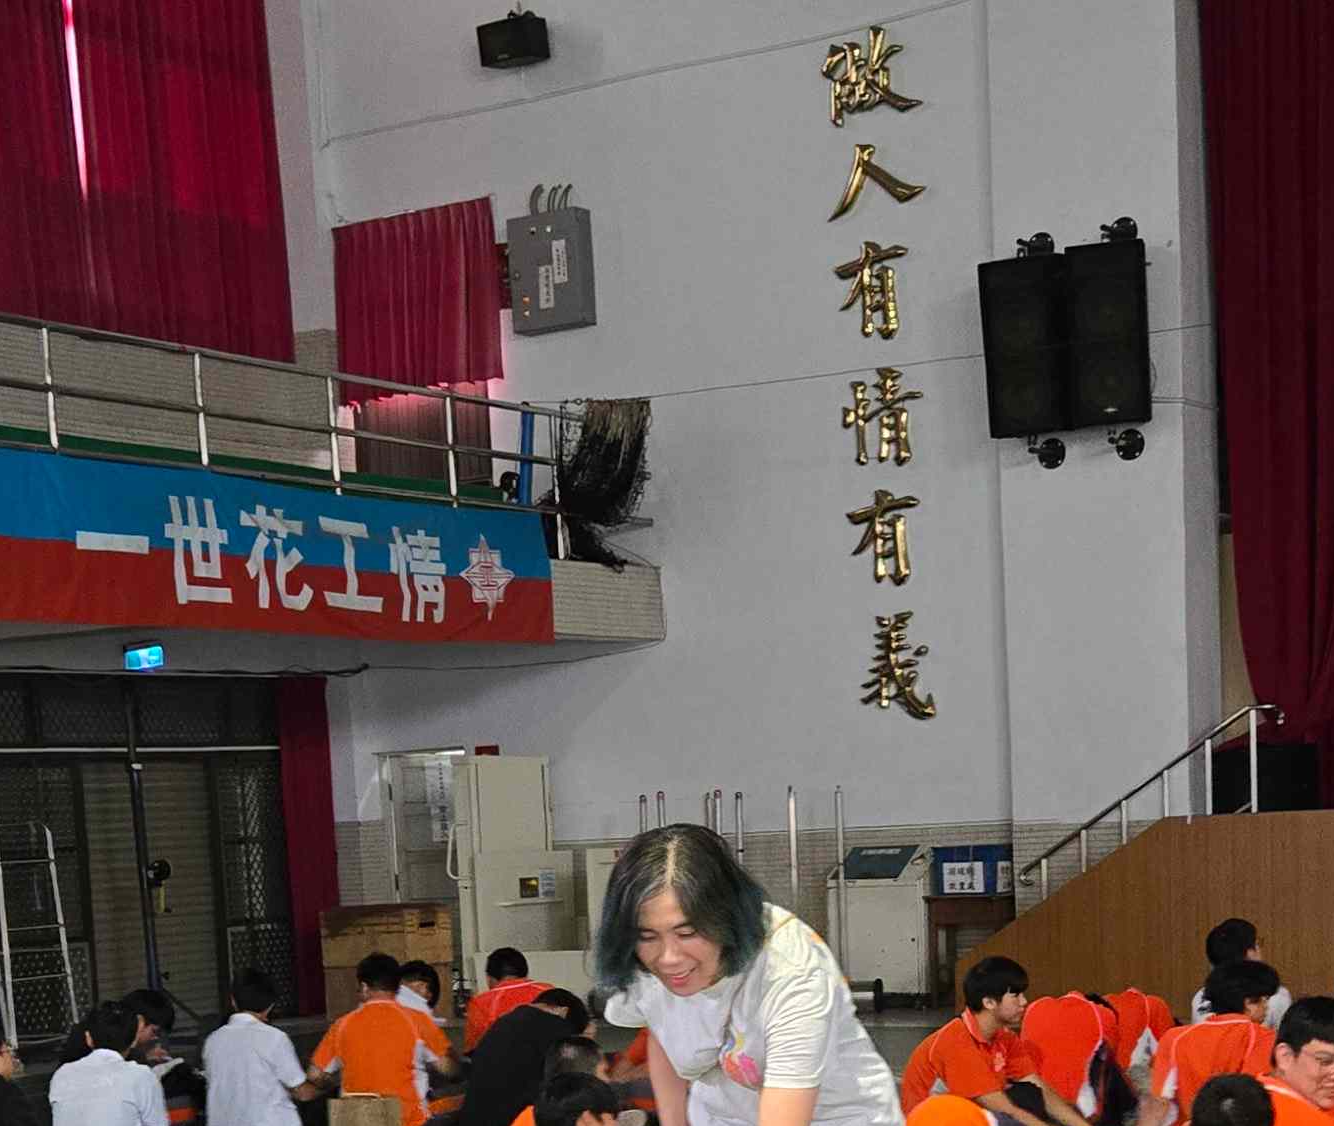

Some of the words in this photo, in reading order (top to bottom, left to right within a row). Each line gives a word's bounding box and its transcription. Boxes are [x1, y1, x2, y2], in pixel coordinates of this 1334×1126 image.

[76, 496, 446, 623] 一世花工情
[820, 26, 936, 719] 做人有情有義
